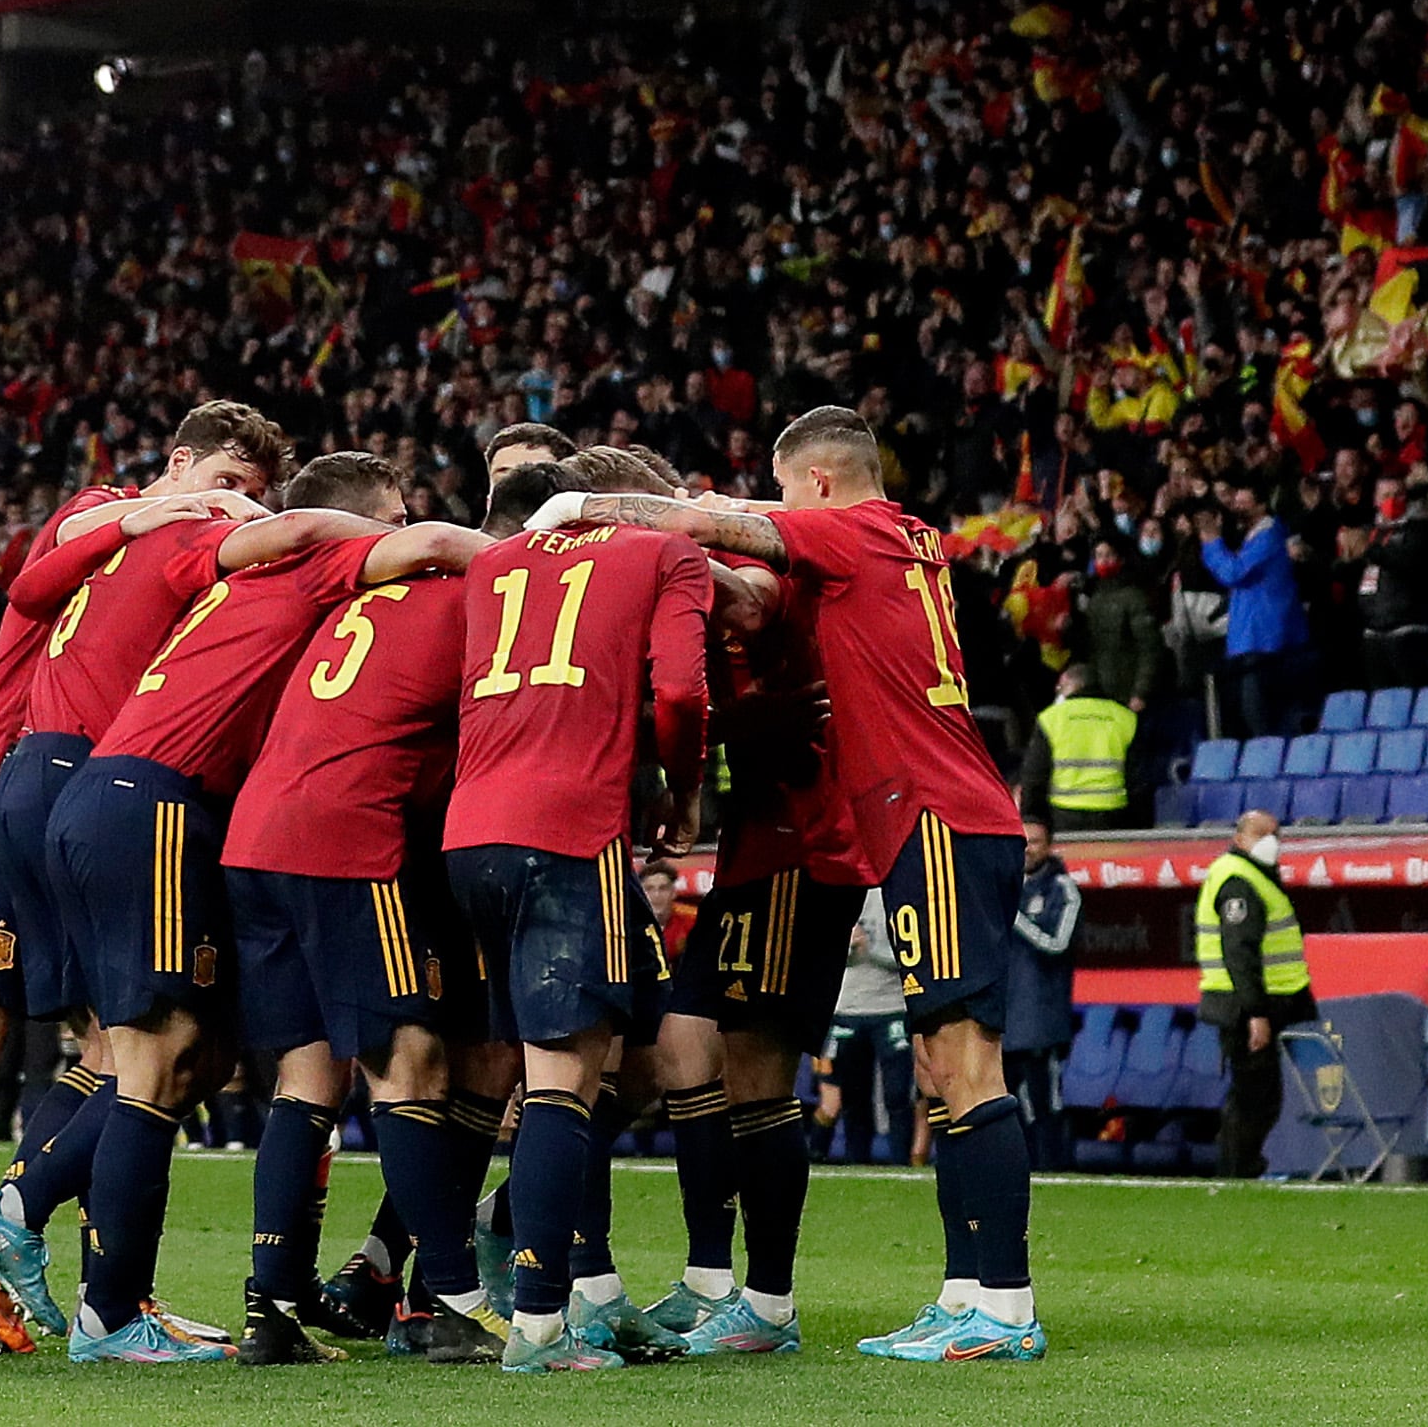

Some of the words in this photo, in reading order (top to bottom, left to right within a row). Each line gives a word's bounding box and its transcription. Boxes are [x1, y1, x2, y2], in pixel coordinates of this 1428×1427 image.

[136, 580, 231, 696] 2
[309, 583, 410, 701] 5
[473, 560, 595, 700] 11
[718, 911, 753, 972] 21
